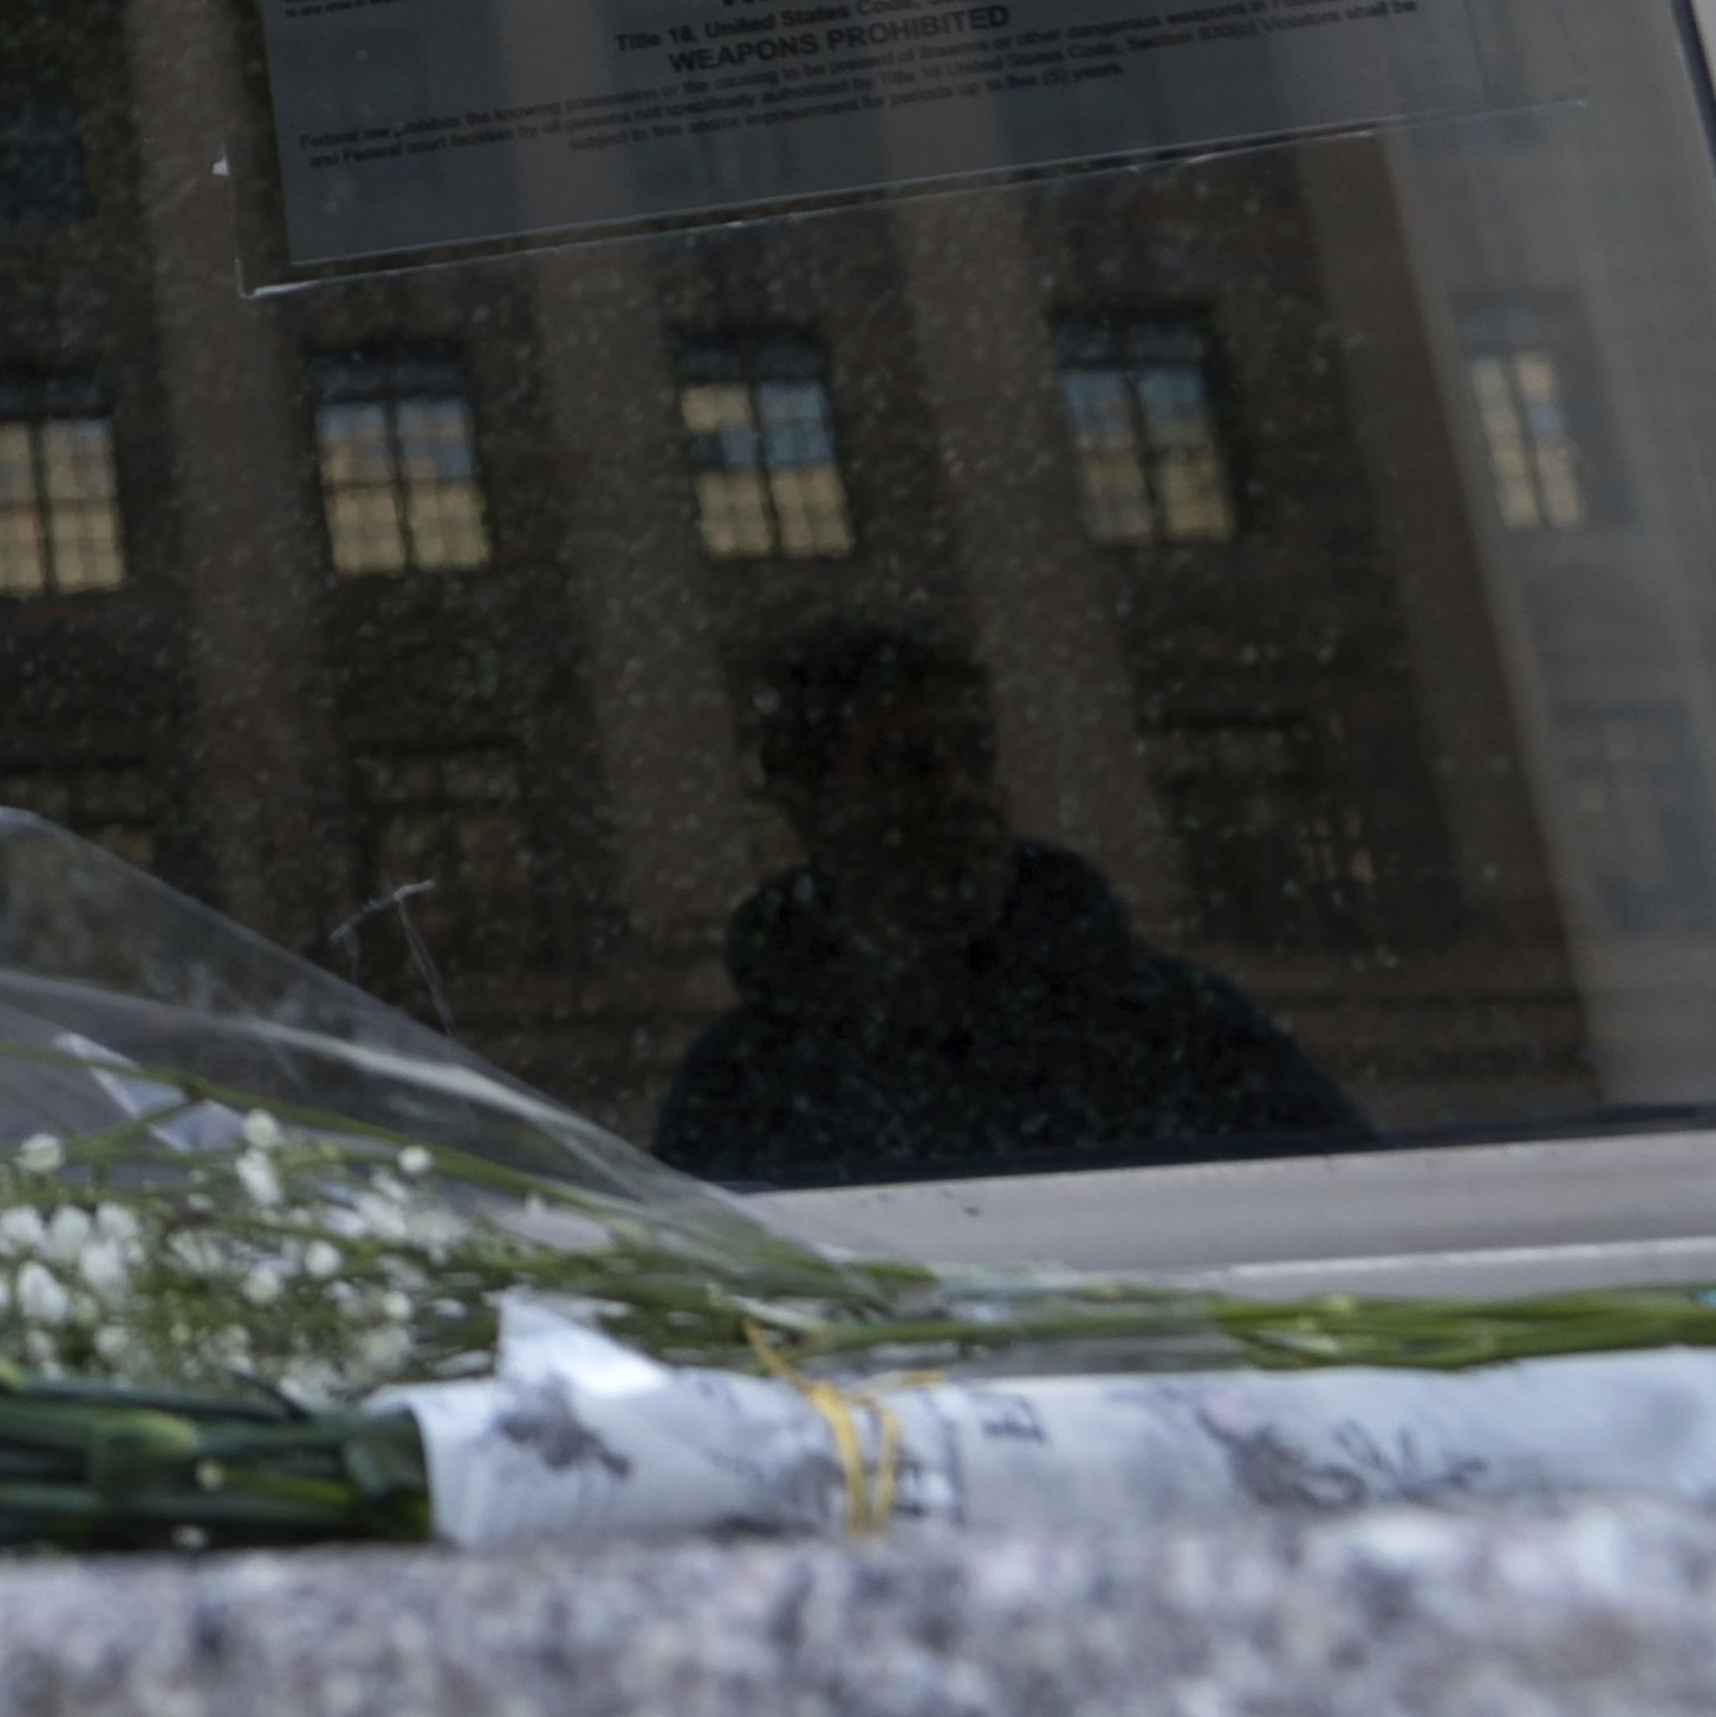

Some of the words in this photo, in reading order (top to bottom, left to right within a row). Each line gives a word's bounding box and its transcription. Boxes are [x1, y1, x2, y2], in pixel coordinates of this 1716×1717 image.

[612, 28, 664, 52] Title
[664, 22, 701, 44] 18,
[701, 9, 778, 39] United
[778, 2, 852, 28] States
[667, 31, 821, 75] WEAPONS
[823, 4, 1012, 52] PROHIBITED
